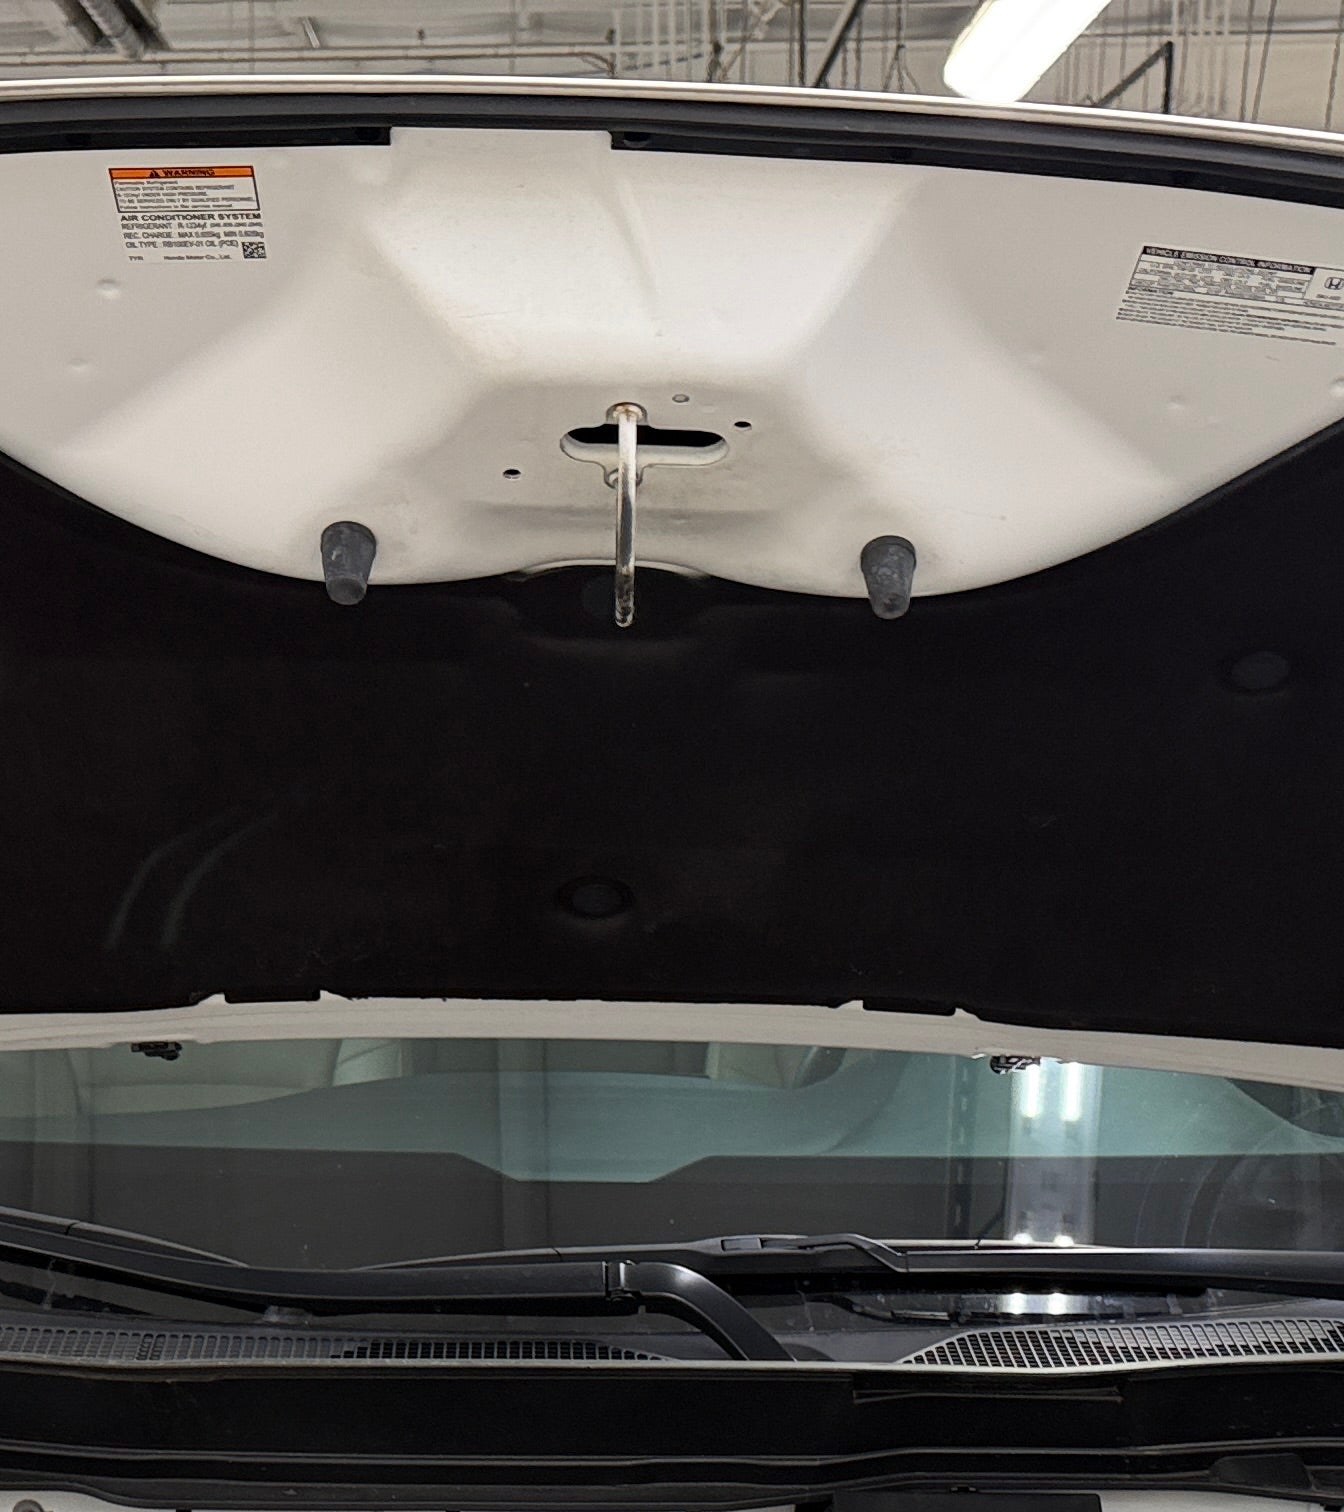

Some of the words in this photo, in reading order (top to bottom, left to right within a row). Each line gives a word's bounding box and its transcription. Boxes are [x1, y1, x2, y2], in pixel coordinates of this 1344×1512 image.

[121, 214, 139, 222] AIR
[141, 213, 216, 221] CONDITIONER
[217, 212, 262, 220] SYSTEM
